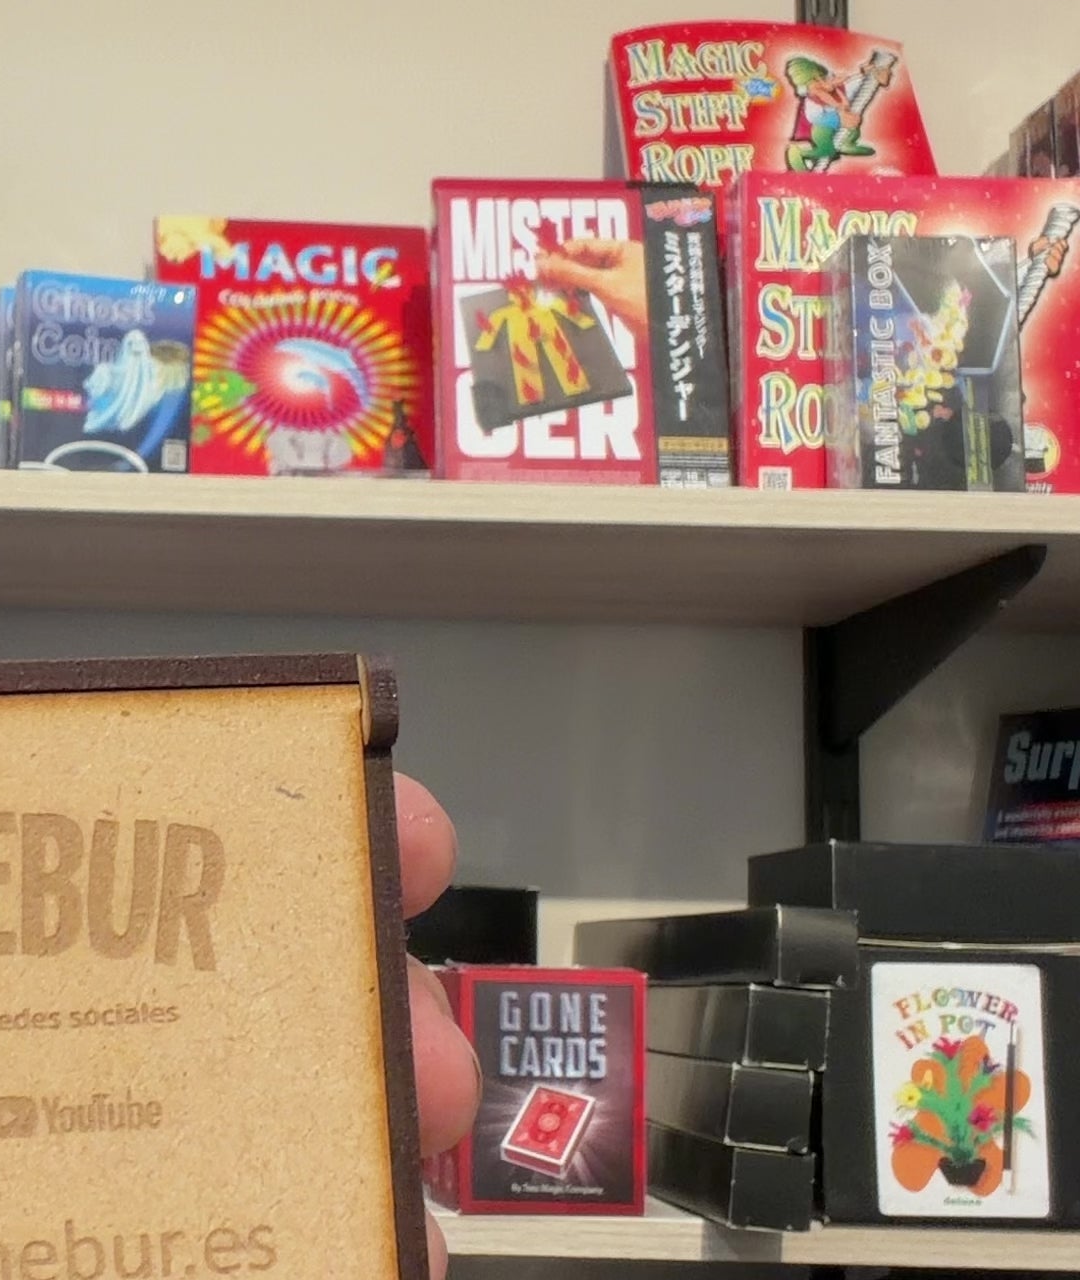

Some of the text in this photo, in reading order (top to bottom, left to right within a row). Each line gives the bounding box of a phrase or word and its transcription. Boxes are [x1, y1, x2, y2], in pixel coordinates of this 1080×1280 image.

[627, 40, 766, 86] MAGIC
[635, 92, 750, 135] STIFF
[200, 241, 402, 289] MAGIC
[867, 242, 902, 485] FANTASTIC BOX
[68, 1003, 180, 1027] sociales
[499, 991, 608, 1033] GONE
[893, 987, 1018, 1022] FLOWER
[939, 1014, 996, 1038] POT
[499, 1036, 608, 1078] CARDS
[40, 1089, 164, 1136] YouTube
